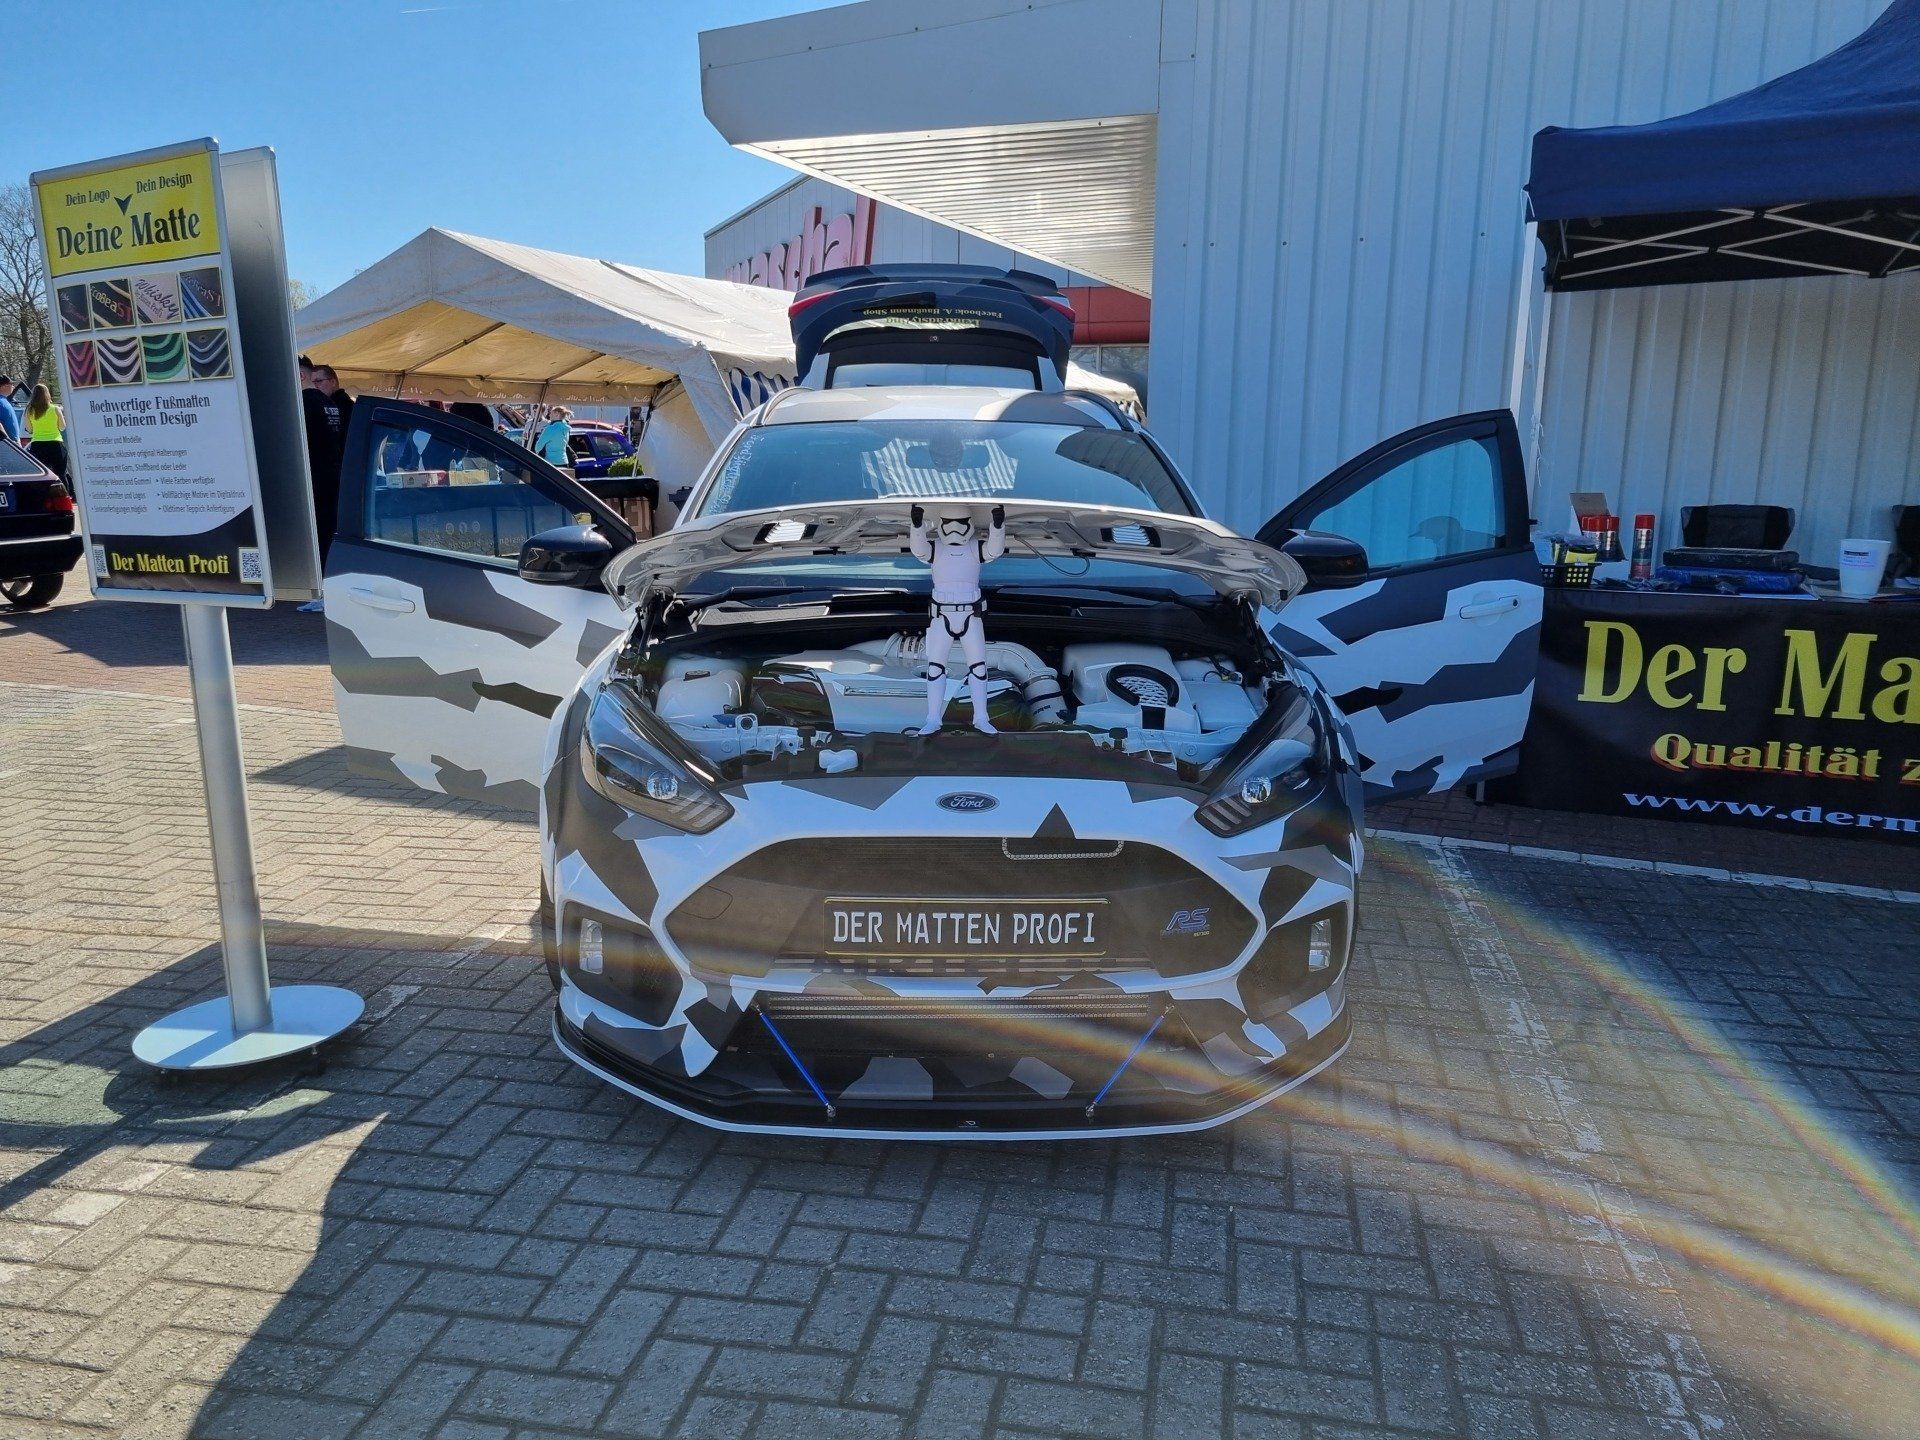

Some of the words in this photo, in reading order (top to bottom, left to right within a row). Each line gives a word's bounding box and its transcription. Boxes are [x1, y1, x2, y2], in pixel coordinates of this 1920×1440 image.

[136, 179, 156, 194] Dein
[159, 172, 193, 190] Design
[65, 193, 86, 207] Dein
[89, 189, 110, 204] Logo
[57, 222, 123, 259] Deine
[131, 208, 201, 247] Matte
[863, 308, 888, 316] Shop
[90, 397, 152, 415] Hochwertige
[155, 394, 210, 411] Fußmatten
[104, 416, 113, 428] in
[116, 413, 157, 427] Deinem
[161, 411, 198, 428] Design
[111, 552, 135, 571] Der
[137, 553, 185, 574] Matten
[189, 554, 230, 575] Profi
[1577, 620, 1747, 712] Der
[1650, 733, 1882, 781] Qualität
[951, 795, 985, 808] Ford
[833, 911, 883, 943] DER
[896, 912, 1000, 944] MATTEN
[1013, 912, 1095, 944] PROFI
[1166, 907, 1211, 930] RS
